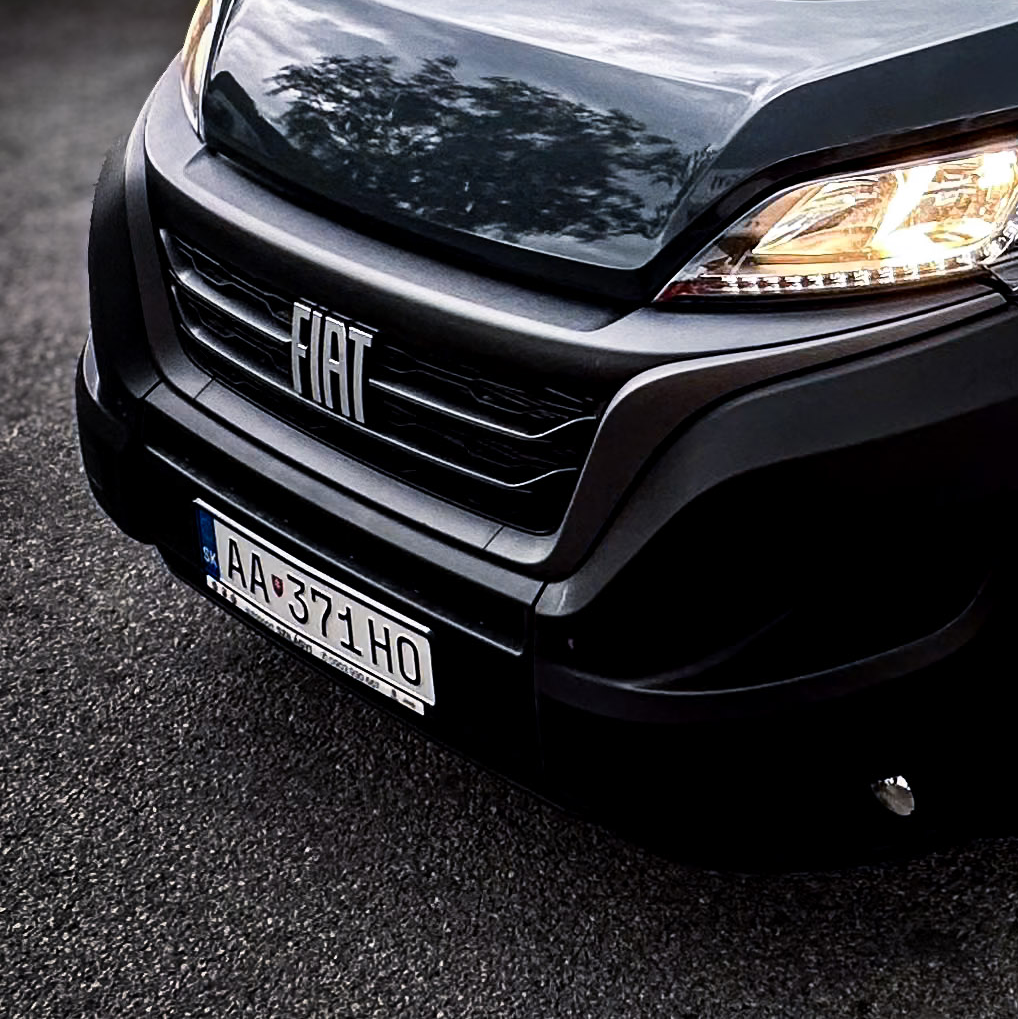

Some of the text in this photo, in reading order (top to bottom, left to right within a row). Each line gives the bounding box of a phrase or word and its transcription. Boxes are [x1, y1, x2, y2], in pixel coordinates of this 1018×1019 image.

[291, 301, 373, 424] FIAT
[203, 546, 217, 568] SK
[228, 538, 270, 604] AA
